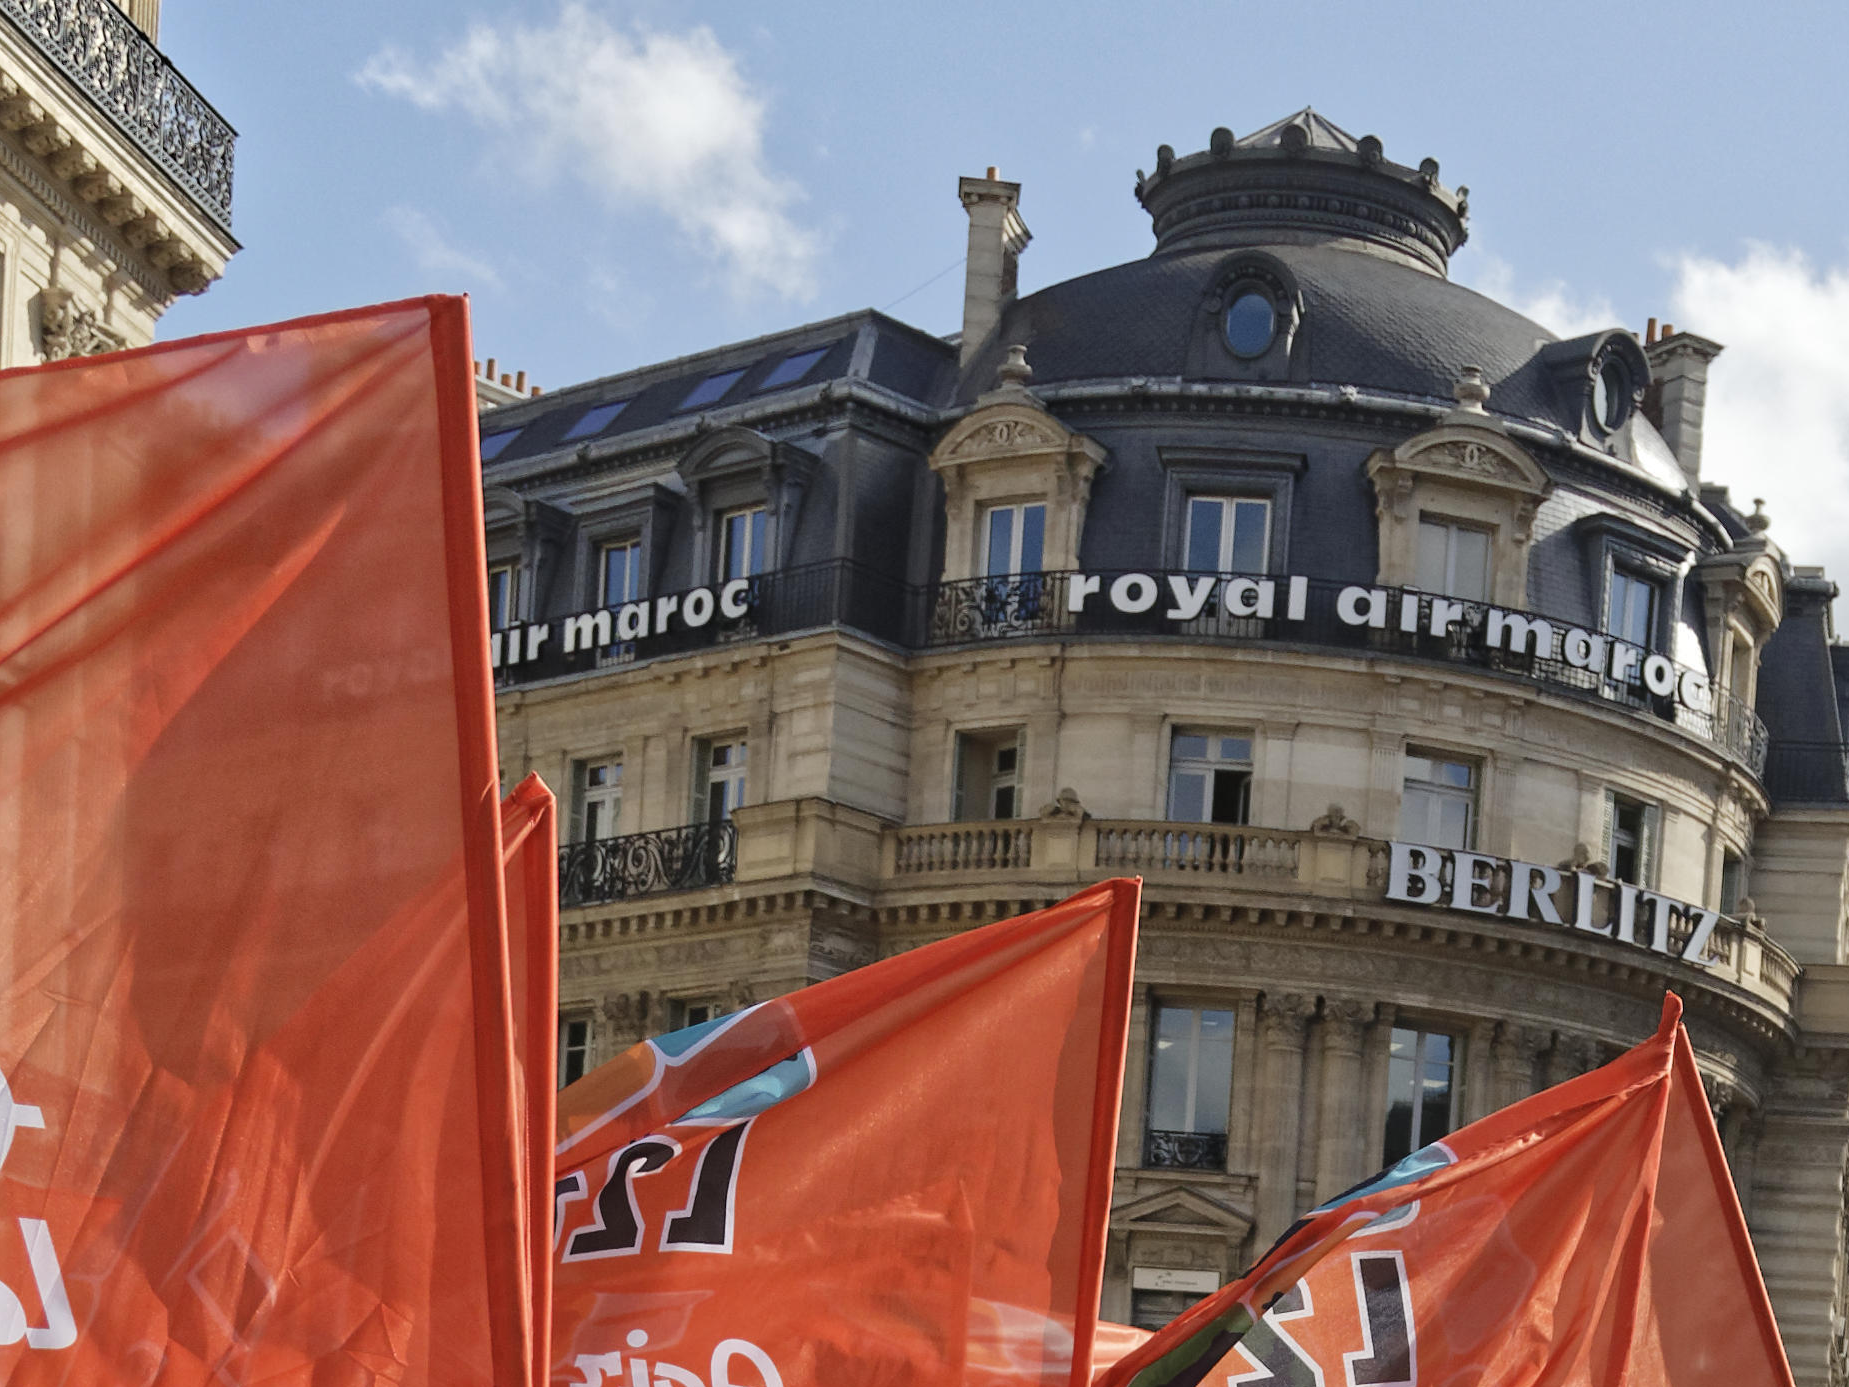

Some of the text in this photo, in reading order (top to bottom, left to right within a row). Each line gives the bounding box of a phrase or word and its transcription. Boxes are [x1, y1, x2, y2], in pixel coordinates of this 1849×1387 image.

[563, 578, 749, 655] maroc
[1067, 571, 1713, 711] royal air maroc
[1384, 841, 1721, 968] BERLITZ
